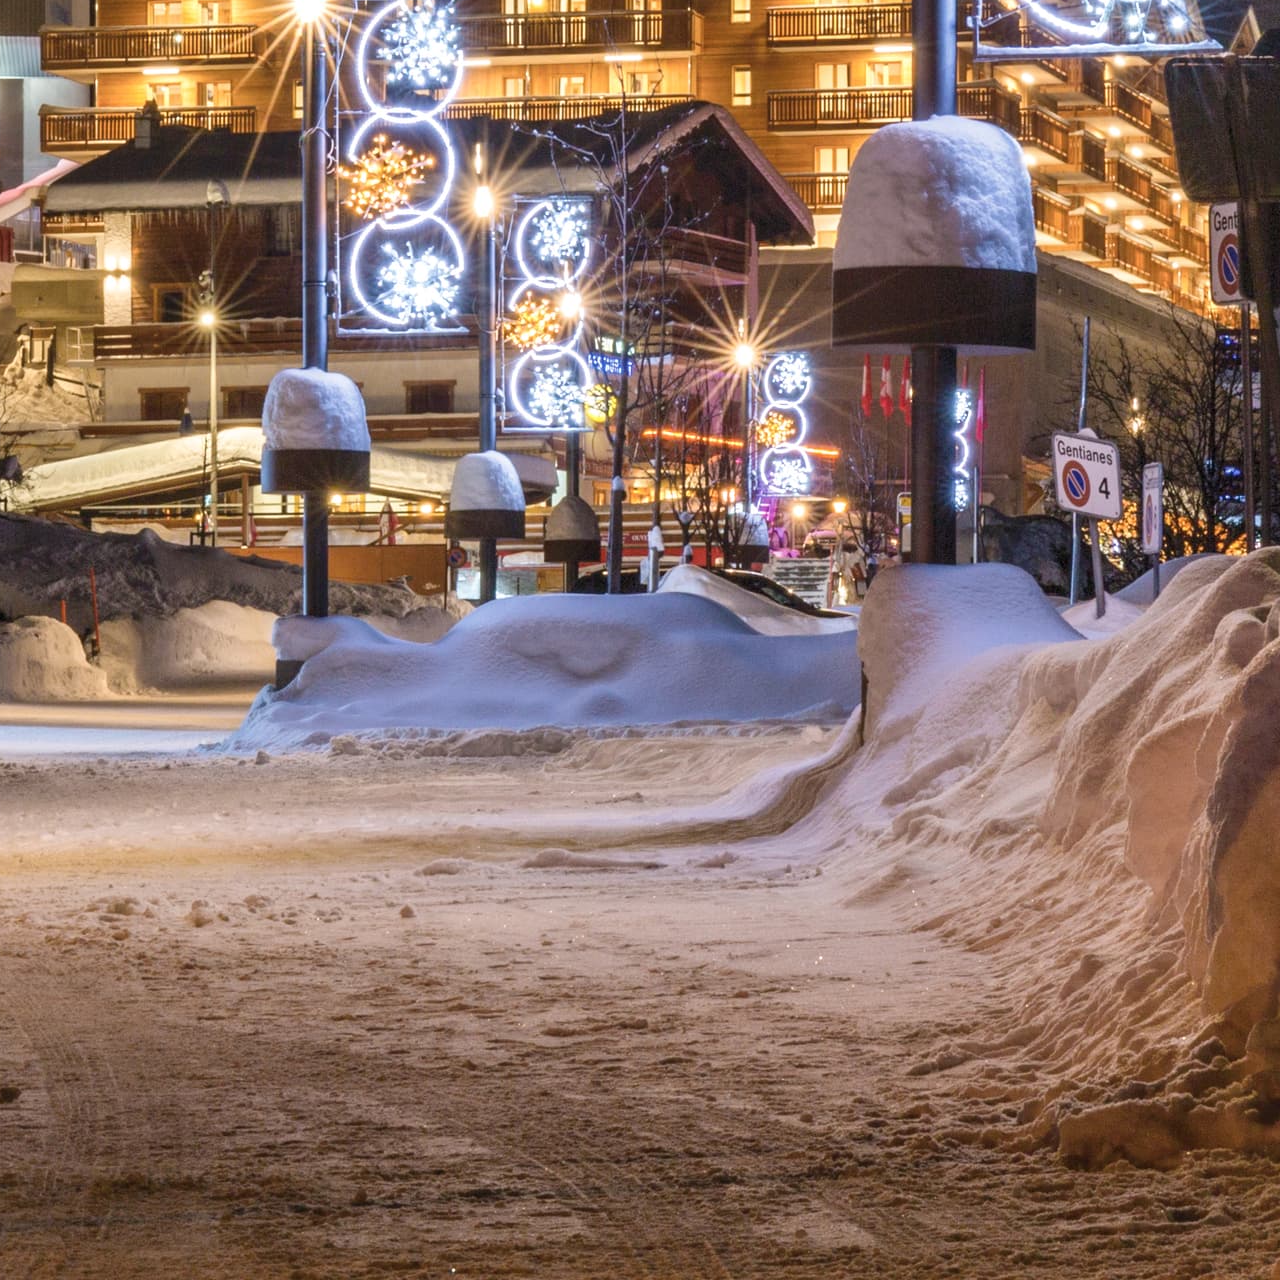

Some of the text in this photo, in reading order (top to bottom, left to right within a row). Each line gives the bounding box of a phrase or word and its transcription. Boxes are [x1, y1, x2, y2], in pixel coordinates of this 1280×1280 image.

[1214, 211, 1239, 232] Gent
[1057, 440, 1113, 466] Gentianes
[1098, 477, 1111, 500] 4
